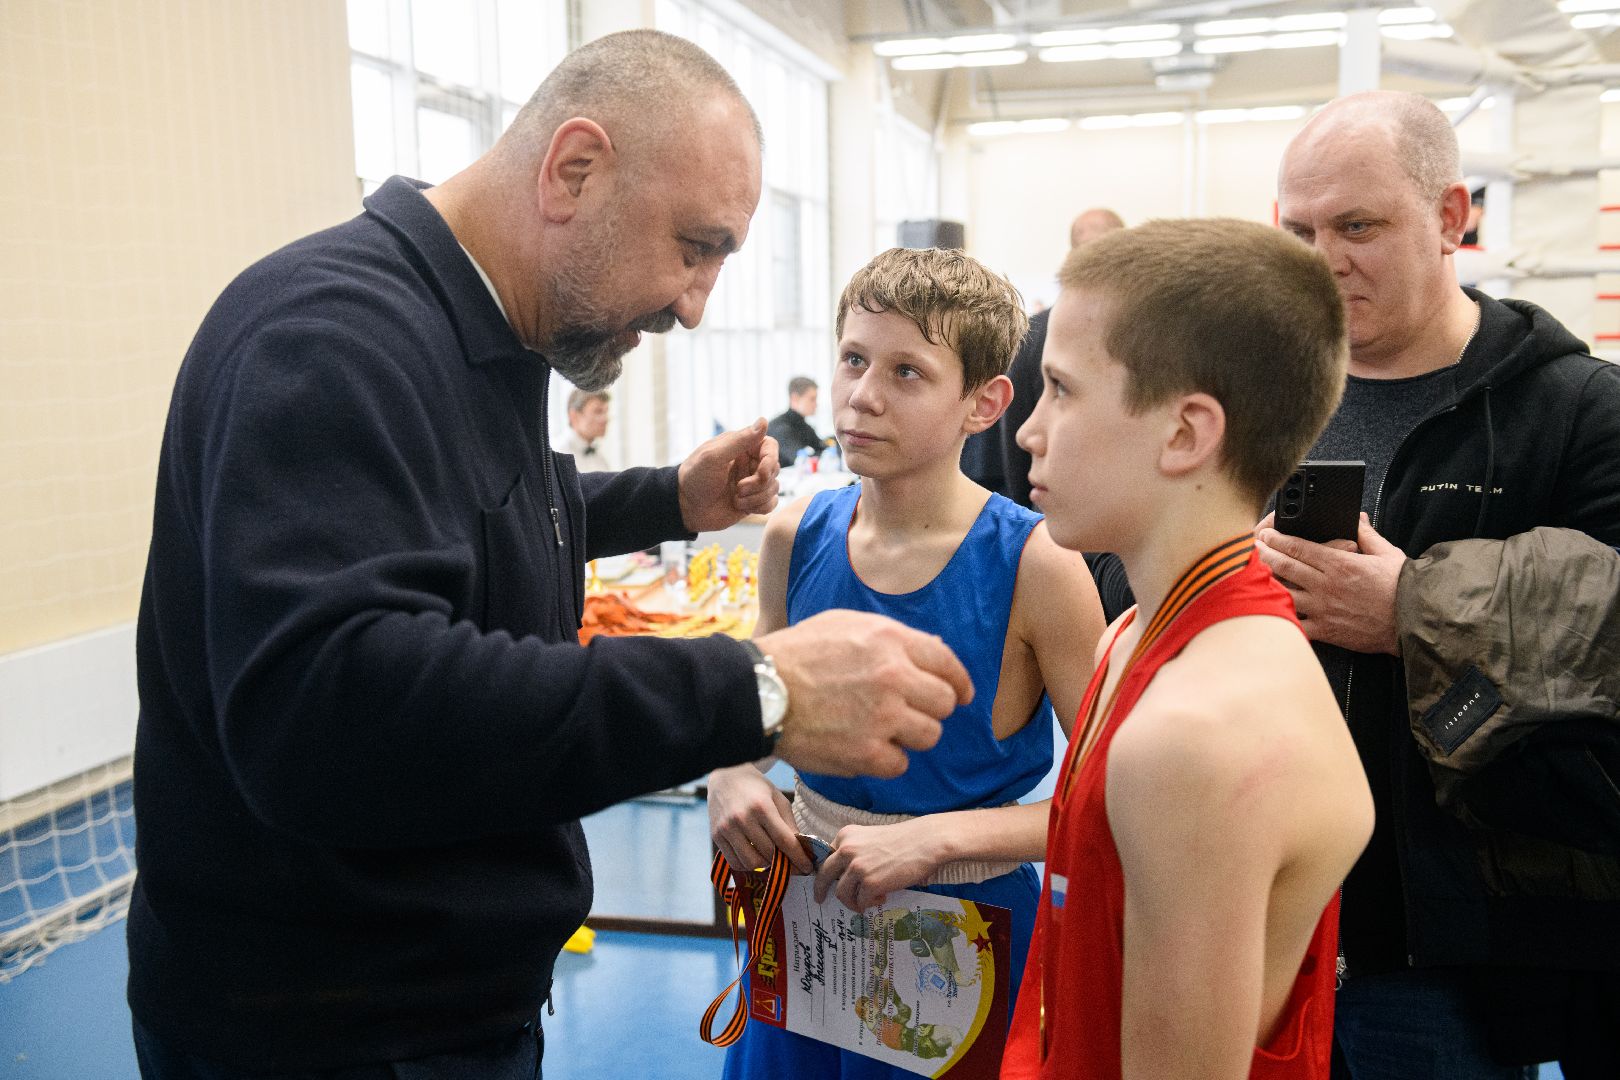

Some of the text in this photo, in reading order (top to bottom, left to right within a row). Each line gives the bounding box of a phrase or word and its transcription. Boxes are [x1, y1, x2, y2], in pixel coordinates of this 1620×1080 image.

[1420, 482, 1503, 494] PUTIN TEM
[847, 928, 856, 942] 44
[792, 920, 801, 973] Награждается
